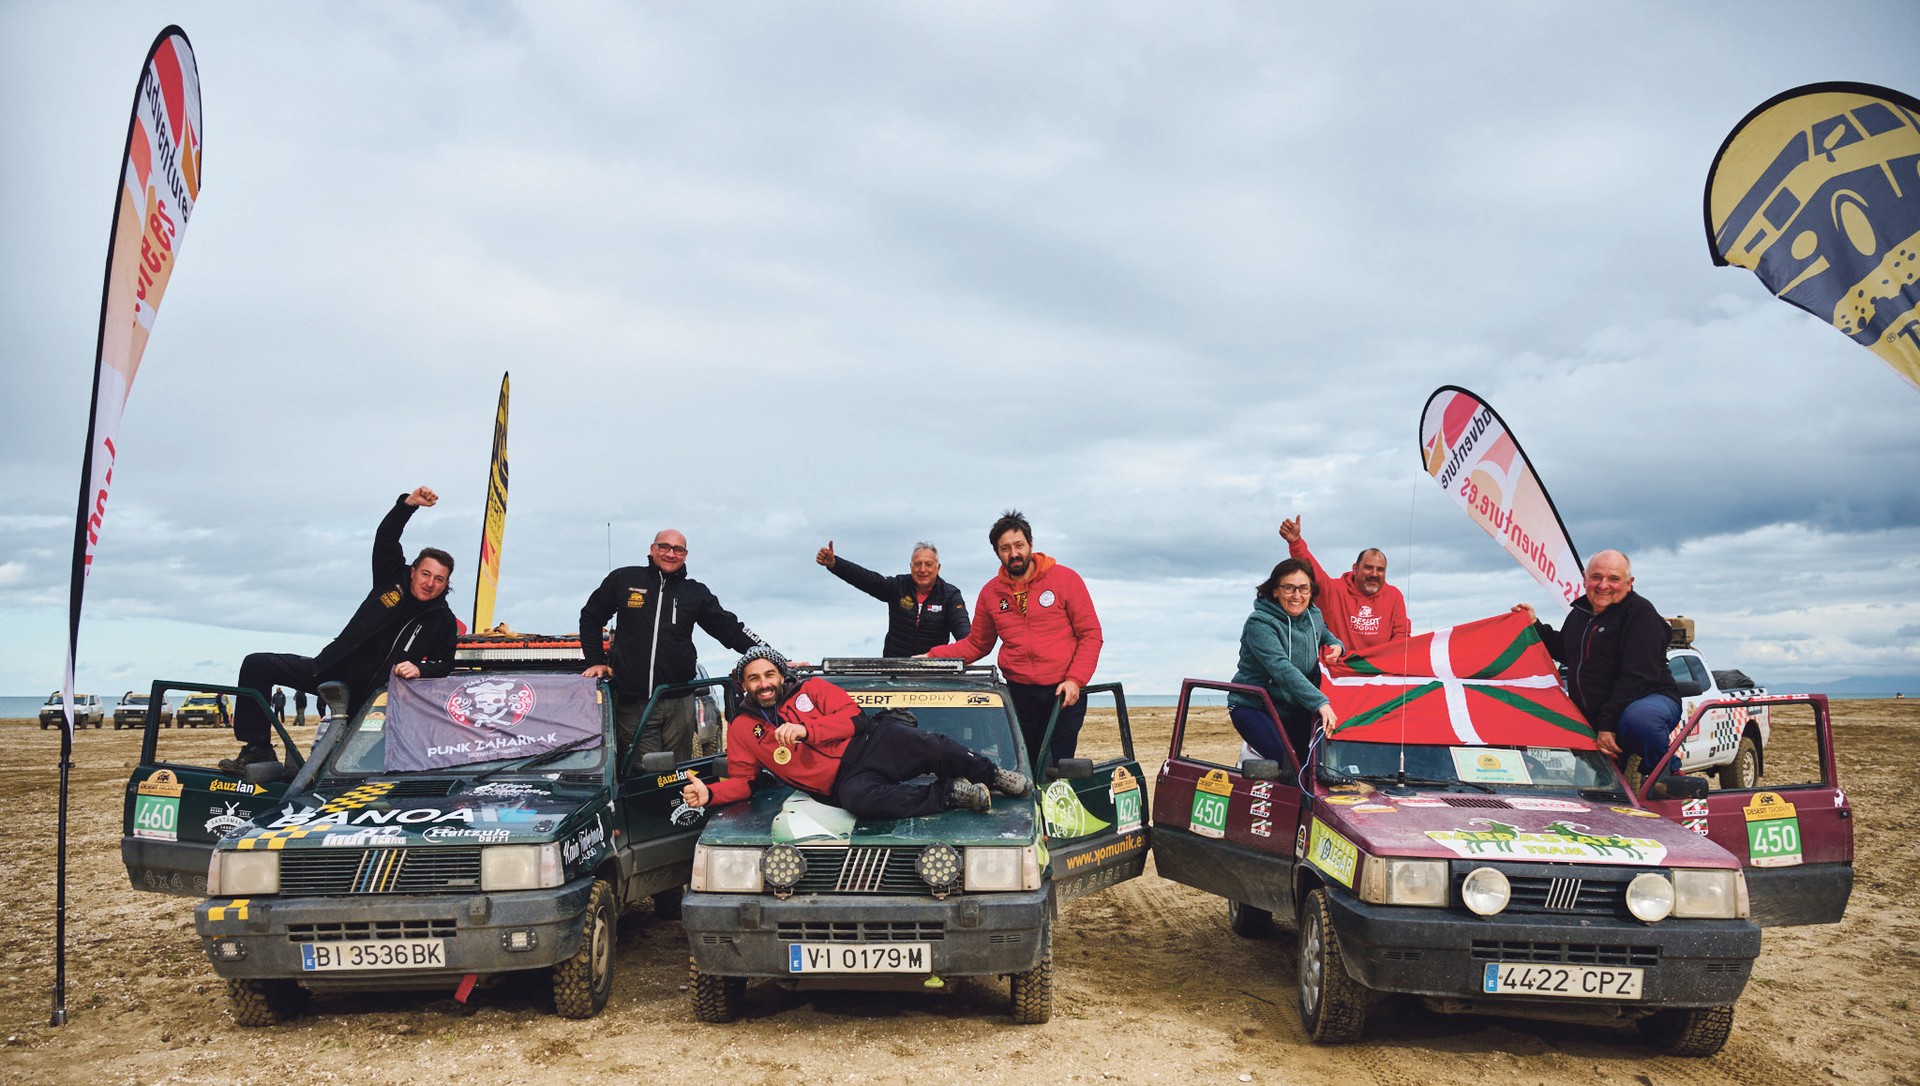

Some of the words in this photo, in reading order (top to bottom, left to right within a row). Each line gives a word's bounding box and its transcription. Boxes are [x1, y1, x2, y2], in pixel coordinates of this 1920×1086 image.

[145, 67, 188, 223] adventure
[902, 693, 956, 702] TROPHY
[427, 742, 471, 758] PUNK
[209, 779, 255, 794] gauzlan
[137, 802, 176, 830] 460
[266, 808, 475, 829] BANOA
[1120, 796, 1140, 823] 424
[1194, 798, 1226, 827] 450
[429, 828, 511, 838] Haitzulo
[1753, 825, 1797, 854] 450
[1522, 844, 1588, 856] TEAM
[143, 869, 183, 891] 4x4
[315, 945, 342, 967] BI
[350, 944, 409, 966] 3536
[411, 942, 442, 965] BK
[793, 960, 799, 968] E
[807, 948, 831, 969] VI
[842, 948, 901, 969] 0179
[908, 948, 923, 969] M
[1488, 979, 1495, 988] E
[1502, 967, 1570, 993] 4422
[1581, 970, 1633, 995] CPZ
